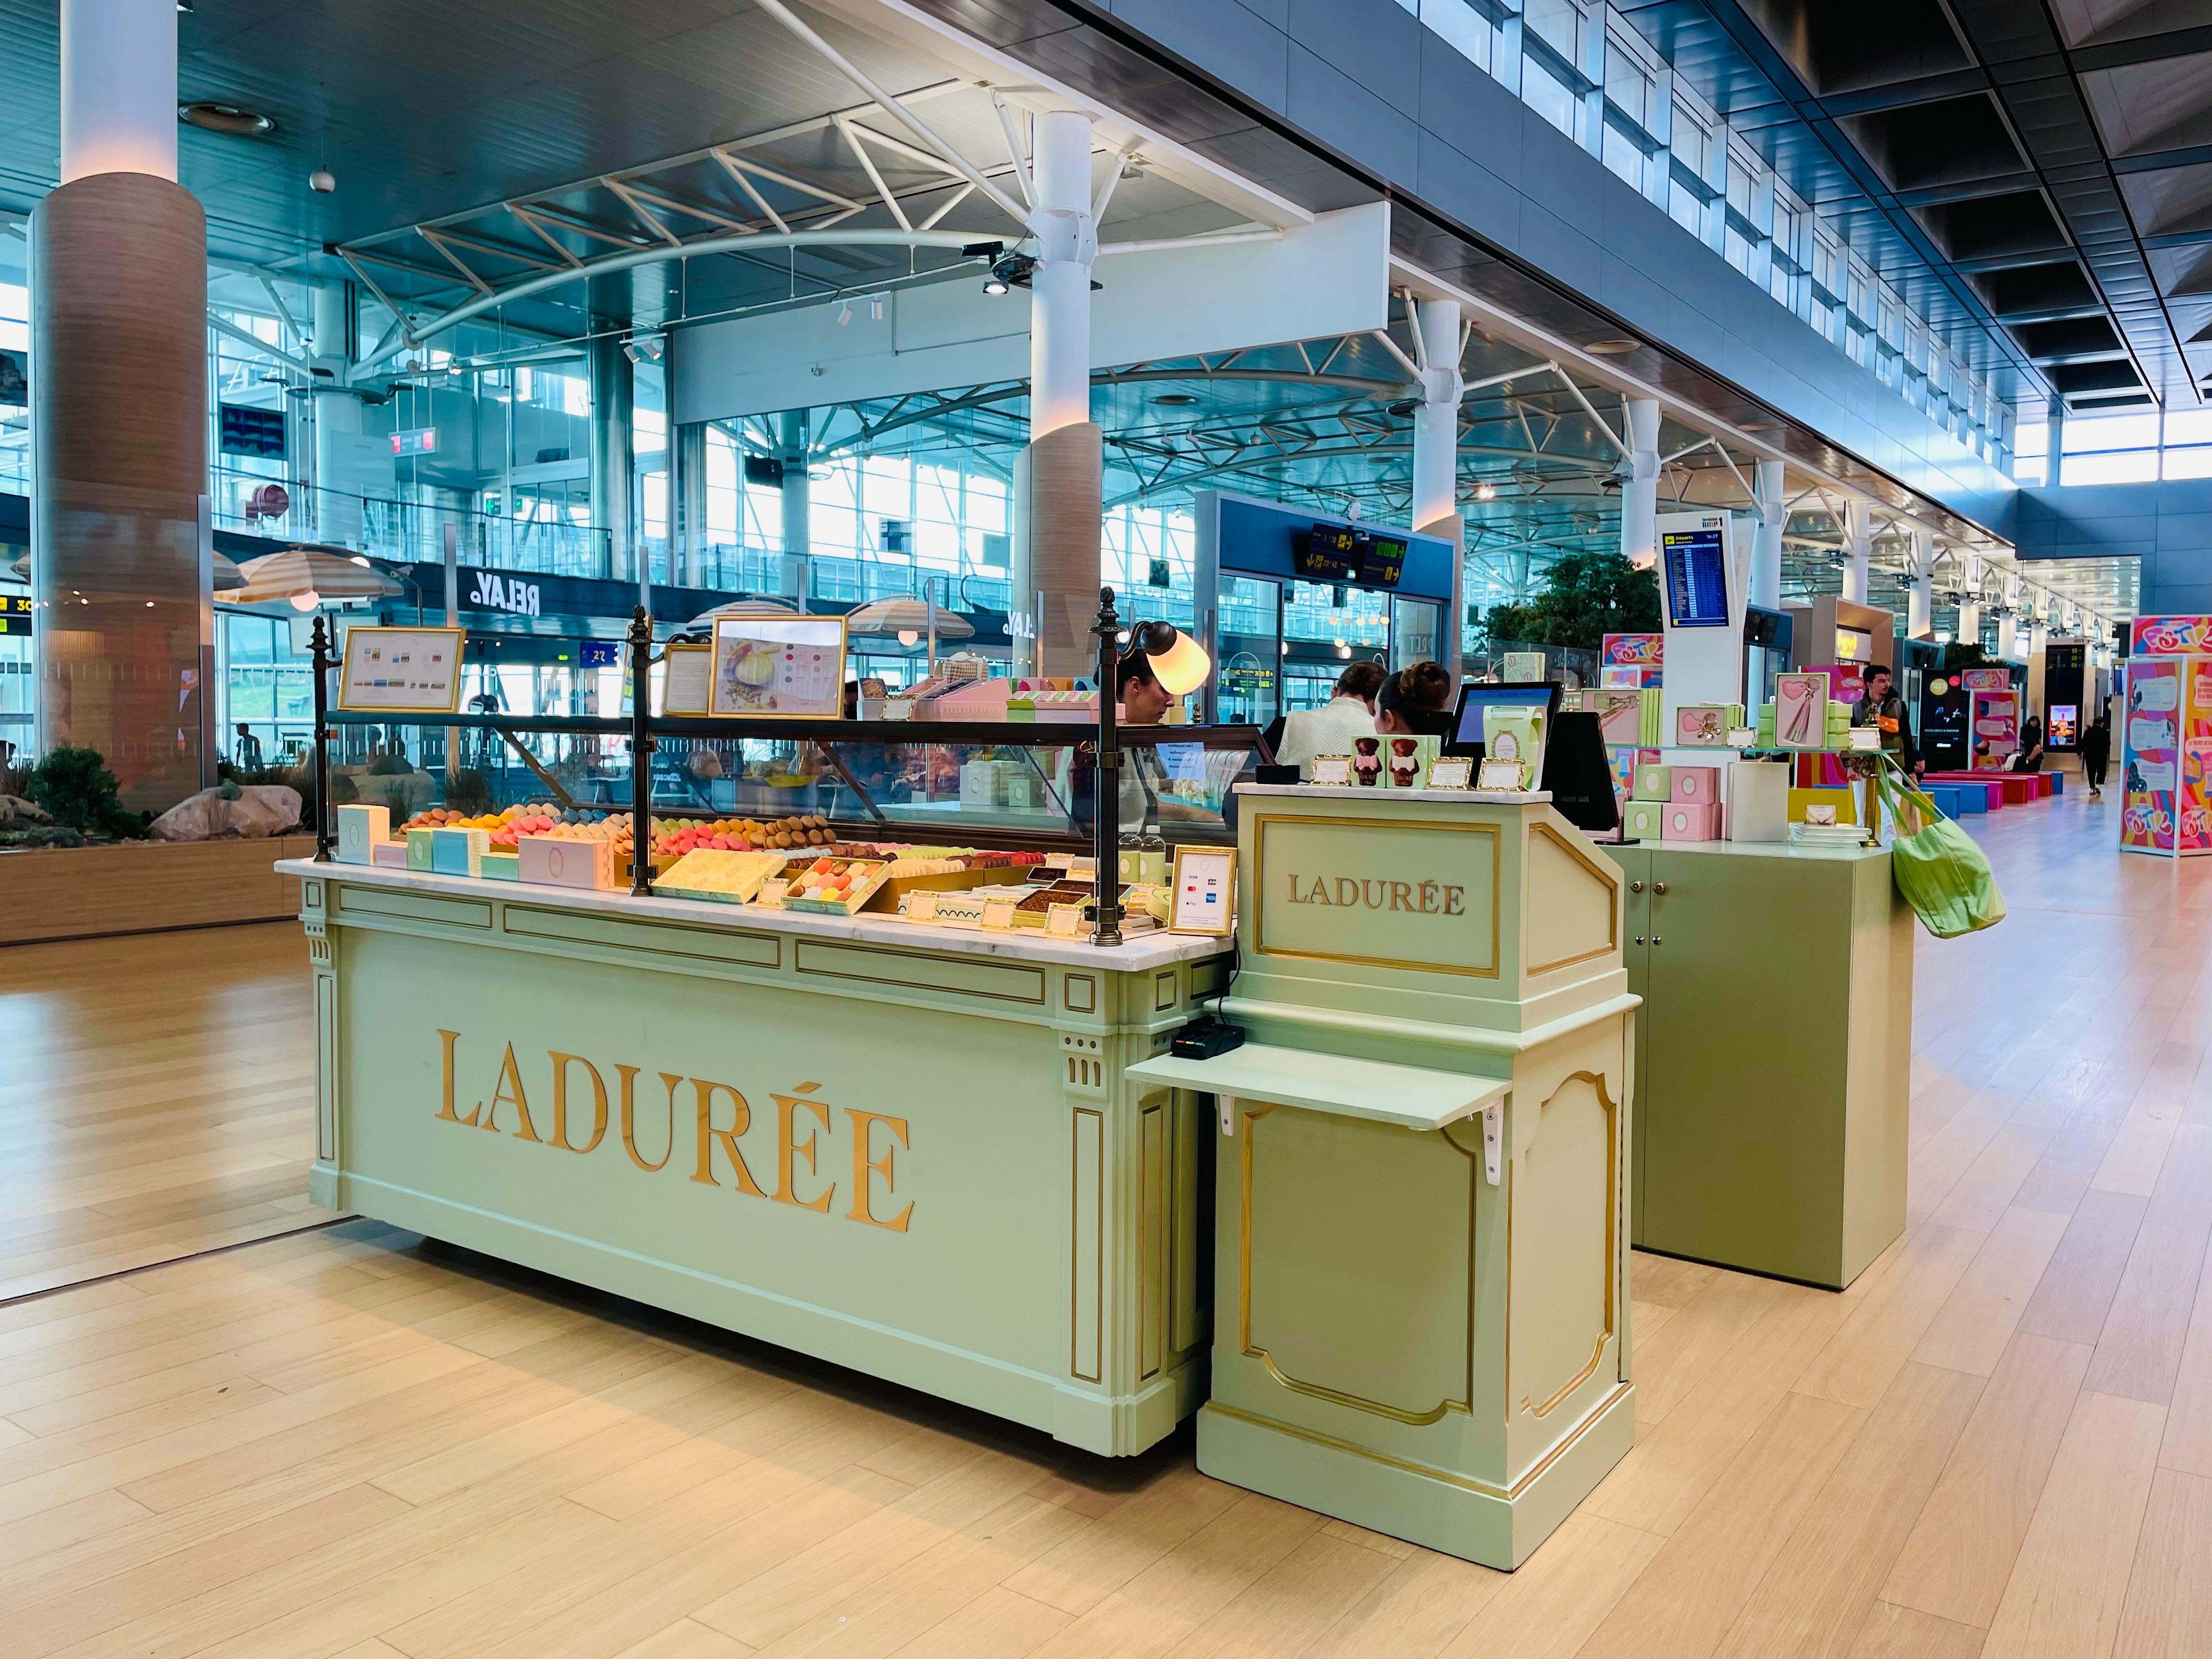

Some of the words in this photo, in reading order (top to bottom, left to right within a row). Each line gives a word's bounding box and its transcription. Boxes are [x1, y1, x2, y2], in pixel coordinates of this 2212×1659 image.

[593, 650, 605, 662] 27
[1288, 873, 1465, 916] LADURÉE
[434, 1028, 915, 1233] LADURÉE
